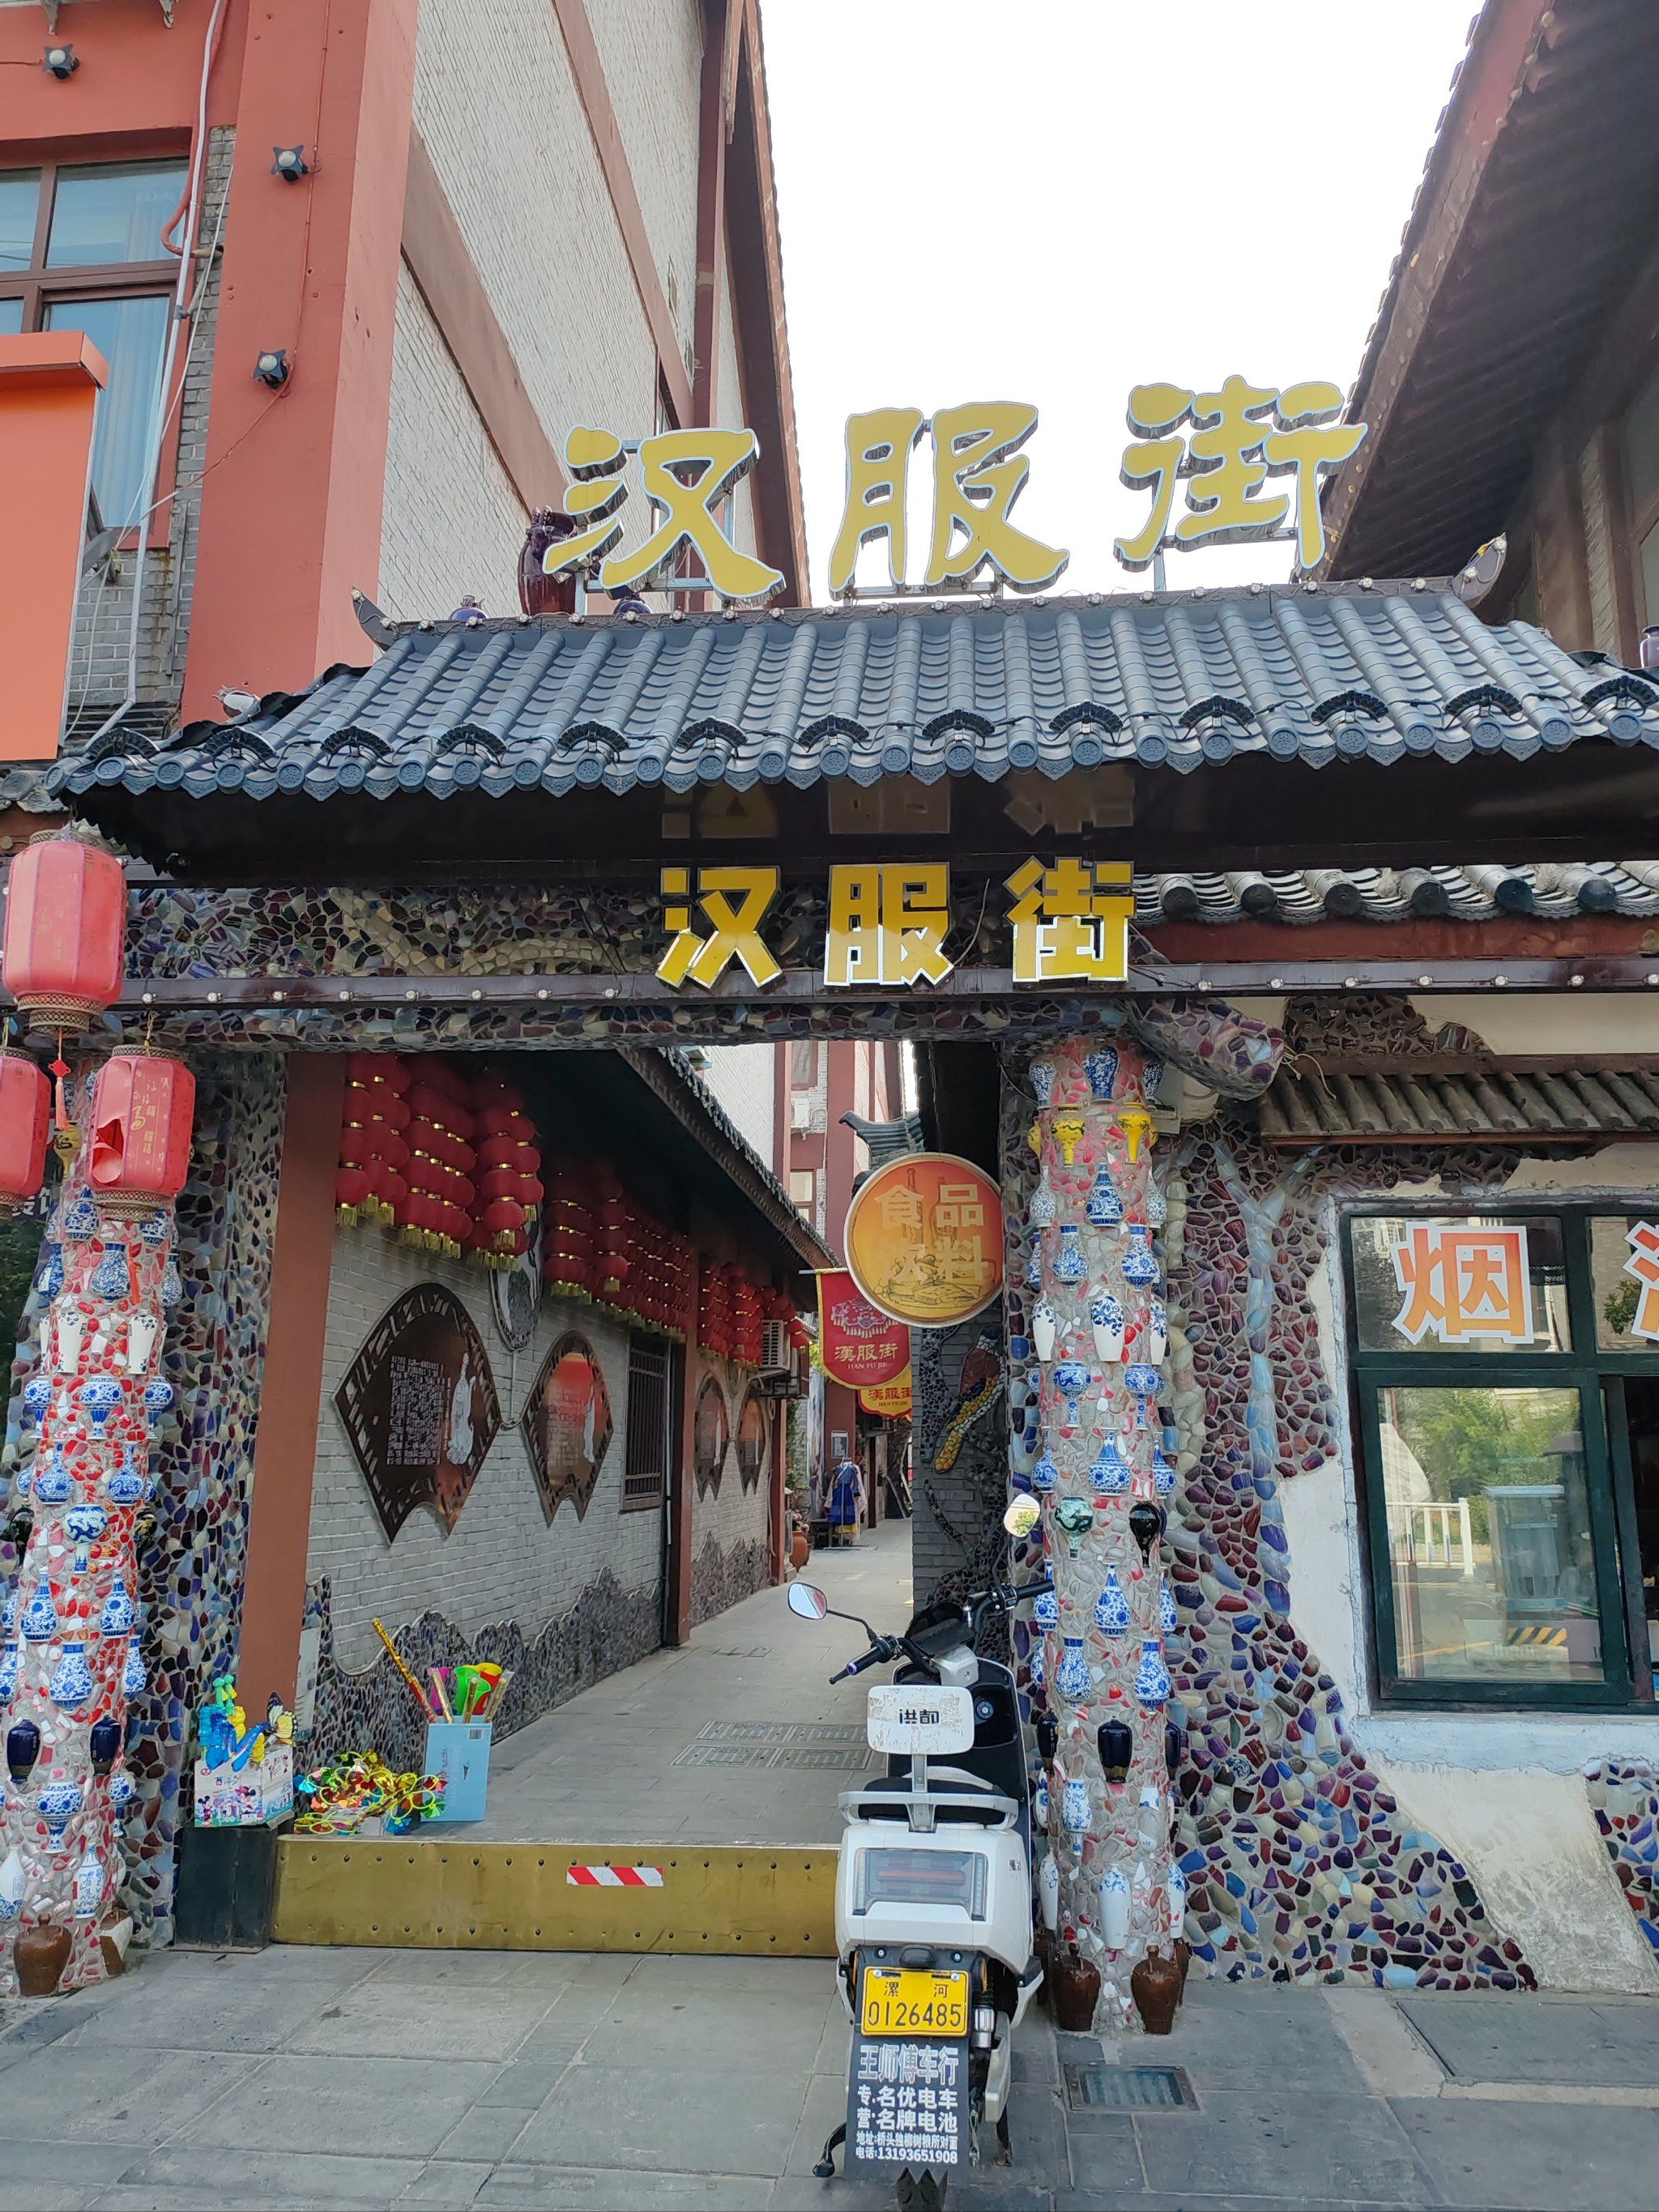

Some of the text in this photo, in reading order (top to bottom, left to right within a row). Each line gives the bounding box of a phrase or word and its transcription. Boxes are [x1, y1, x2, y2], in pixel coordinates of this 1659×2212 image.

[542, 374, 1369, 606] 汉服街
[654, 855, 1136, 990] 汉服街
[875, 1184, 984, 1229] 食品
[878, 1235, 988, 1283] 饮料
[1393, 1224, 1530, 1341] 烟
[834, 1342, 898, 1362] 漢服街
[883, 1980, 950, 1999] 漯河
[867, 2001, 962, 2027] 0126485
[858, 2043, 959, 2086] 王师傅车行
